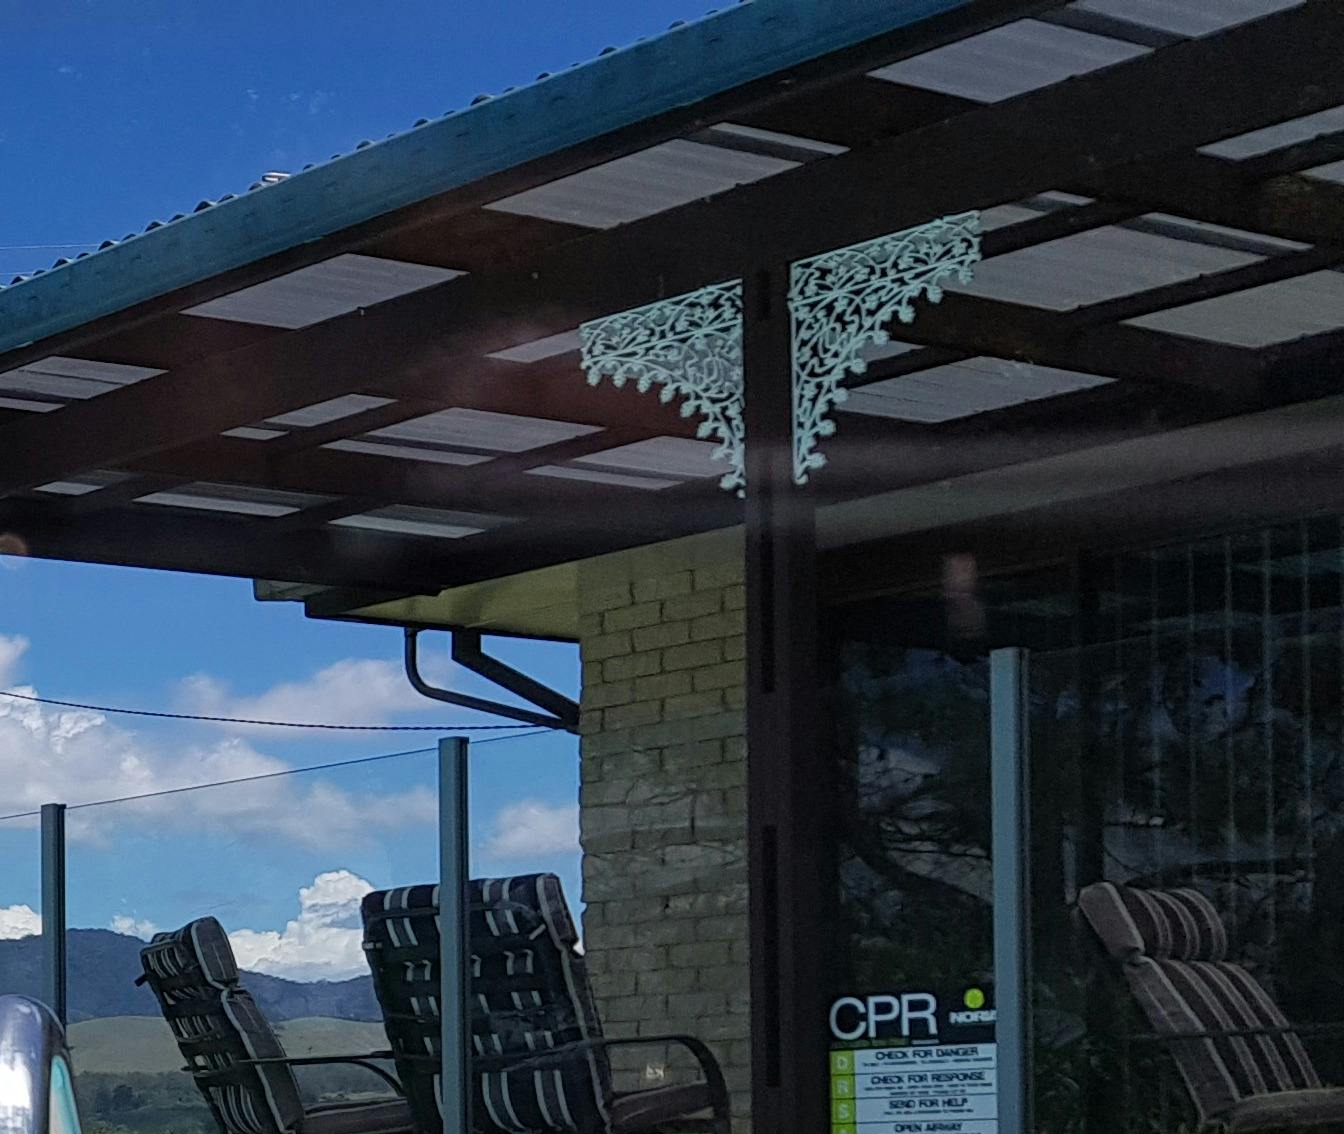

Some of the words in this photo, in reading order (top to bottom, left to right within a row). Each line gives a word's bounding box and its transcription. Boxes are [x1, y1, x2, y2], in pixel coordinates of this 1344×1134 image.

[829, 992, 939, 1041] CPR
[875, 1051, 909, 1061] CHECK
[912, 1049, 933, 1059] FOR
[936, 1047, 979, 1058] DANGER
[870, 1075, 904, 1085] CHECK
[907, 1074, 929, 1083] FOR
[931, 1071, 986, 1082] RESPONSE
[889, 1099, 916, 1109] SEND
[918, 1098, 940, 1108] FOR
[942, 1097, 968, 1107] HELP
[894, 1122, 922, 1133] OPEN
[924, 1122, 963, 1132] AIRWAY
